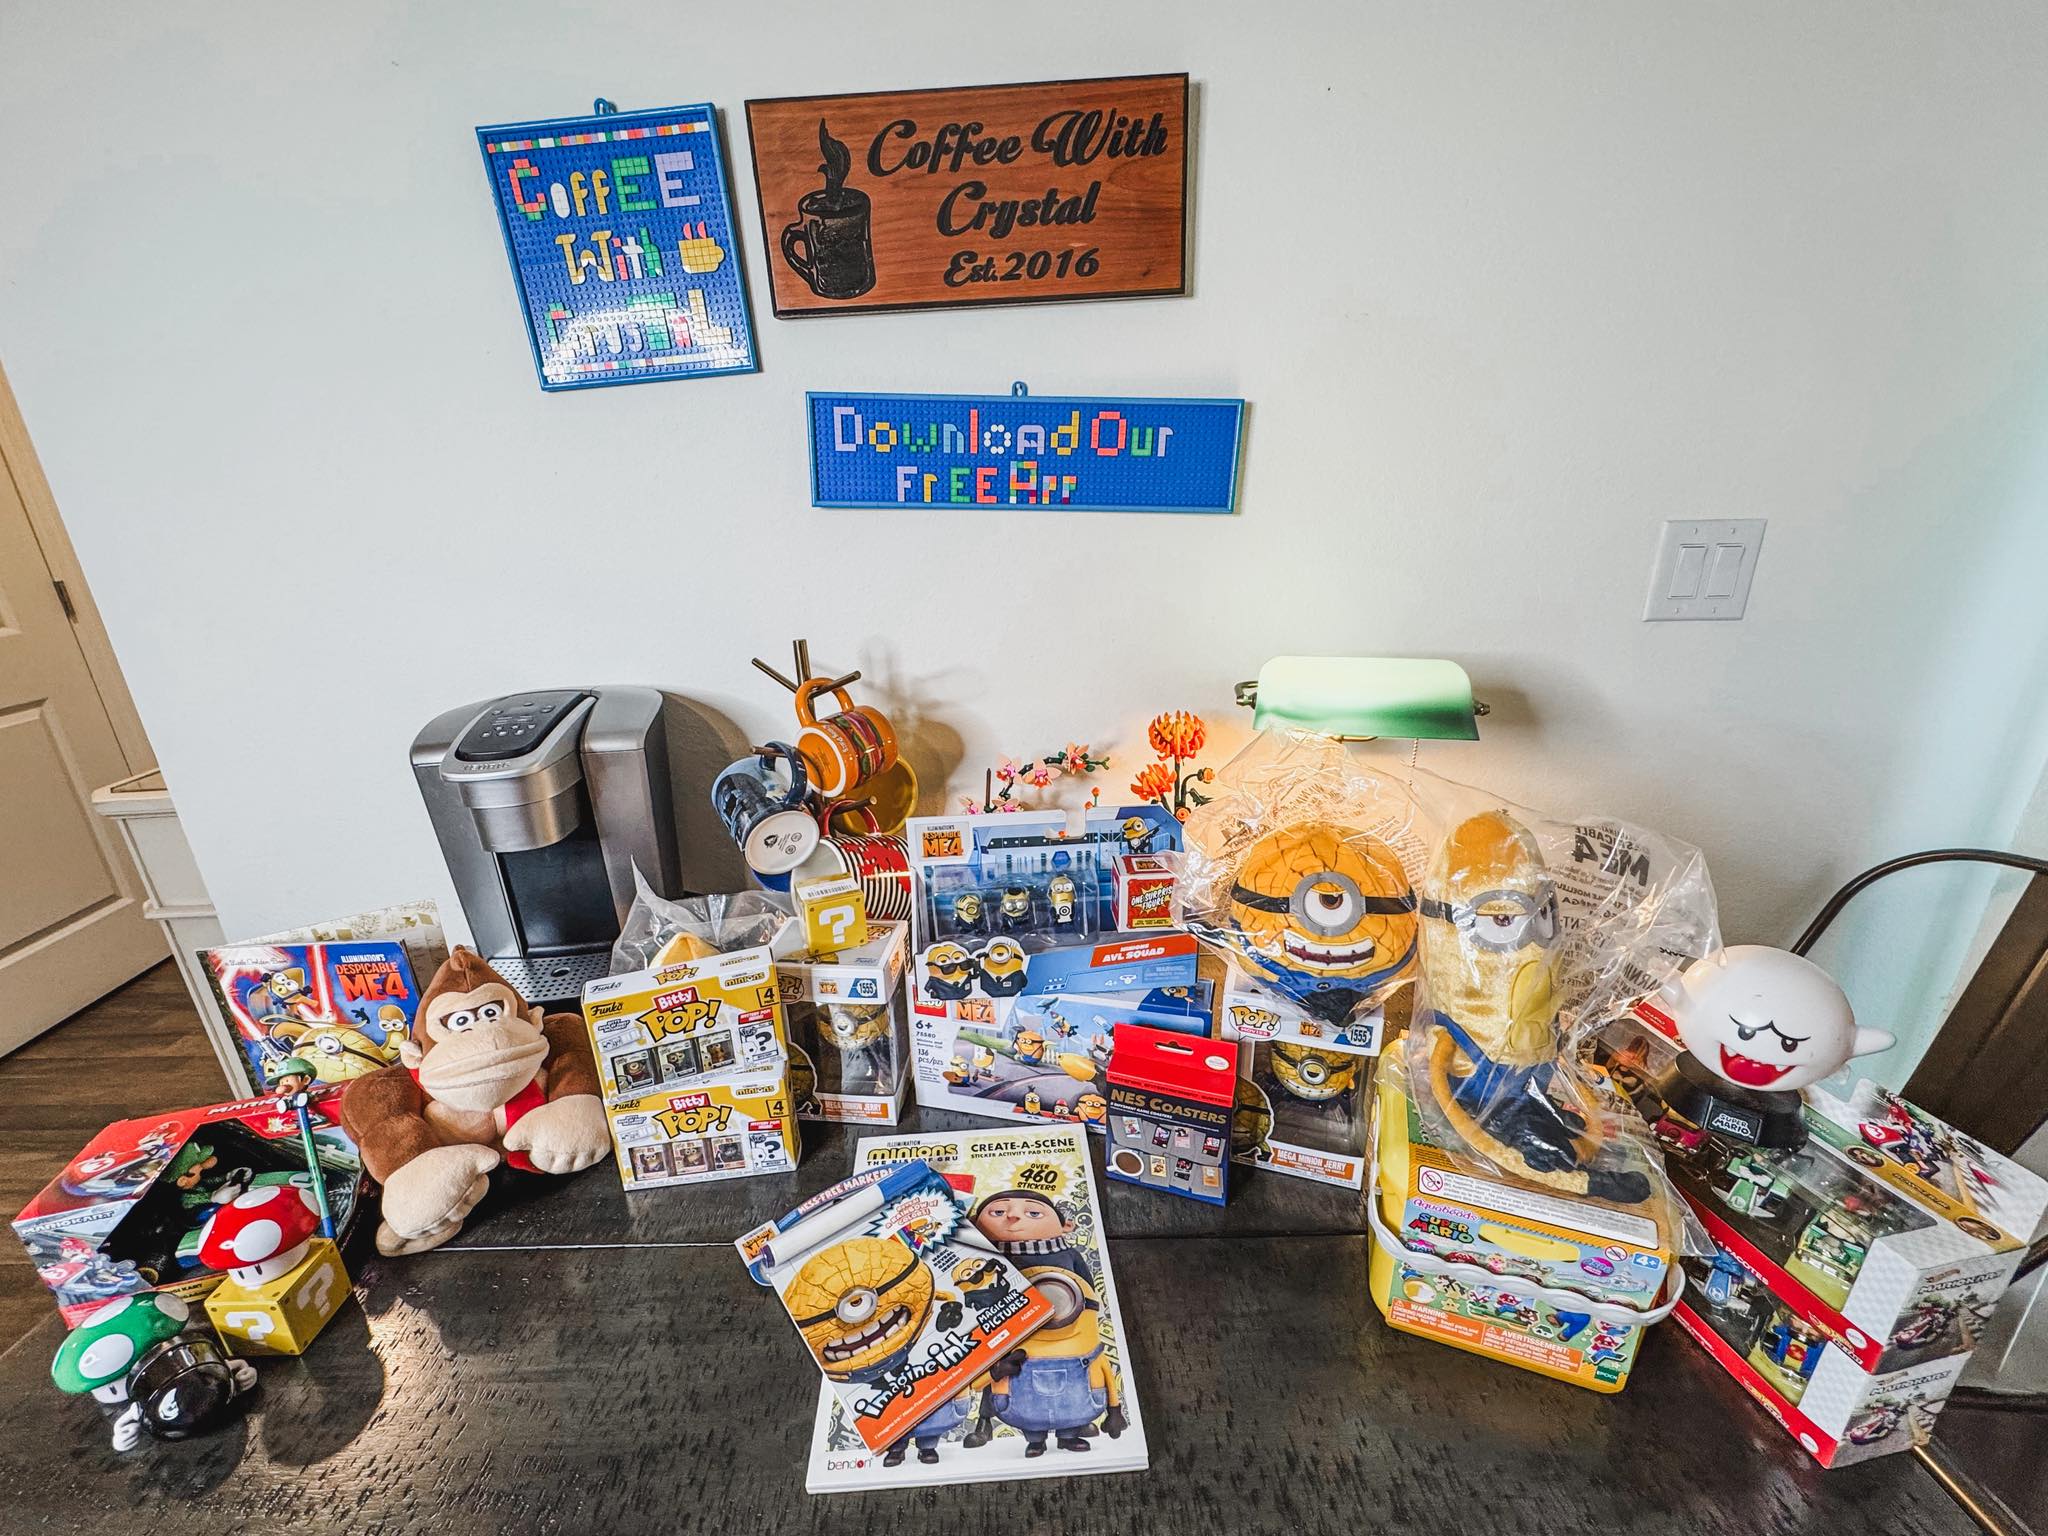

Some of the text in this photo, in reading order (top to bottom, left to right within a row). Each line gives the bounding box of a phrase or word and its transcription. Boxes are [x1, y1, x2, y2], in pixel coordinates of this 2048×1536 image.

[867, 108, 1169, 177] Coffee With
[936, 180, 1102, 239] Crystal
[1102, 947, 1165, 962] AVL SQUAD
[335, 962, 399, 975] DESPICABLE
[763, 987, 775, 998] 4
[859, 982, 875, 994] 1555
[590, 1002, 624, 1016] Funko
[657, 989, 693, 1010] Bitty
[637, 999, 722, 1043] POP!
[915, 1020, 933, 1029] 6+
[1229, 1006, 1281, 1031] POP!
[1350, 1028, 1368, 1043] 1555
[672, 1094, 706, 1111] Bitty
[773, 1101, 784, 1111] 4
[1111, 1088, 1146, 1107] NES
[1149, 1098, 1228, 1125] COASTERS
[652, 1105, 733, 1139] POP!
[1712, 1117, 1751, 1136] MARIO
[1720, 1113, 1748, 1127] SUPER
[970, 1138, 1075, 1152] CREATE-A-SCENE
[1019, 1168, 1058, 1184] 460
[1016, 1181, 1056, 1192] STICKERS
[798, 1184, 844, 1215] MESS-FREE
[891, 1201, 929, 1222] RAINBOW
[1408, 1219, 1474, 1244] MARIO
[1419, 1212, 1469, 1233] SUPER
[1636, 1255, 1657, 1266] 4+
[1724, 1246, 1769, 1286] PACOTES
[977, 1291, 1019, 1323] MAGIC INK
[982, 1295, 1029, 1333] PICTURES
[928, 1331, 982, 1371] ink
[1502, 1330, 1570, 1355] AVERTISSEMENT:
[828, 1458, 870, 1471] bendon
